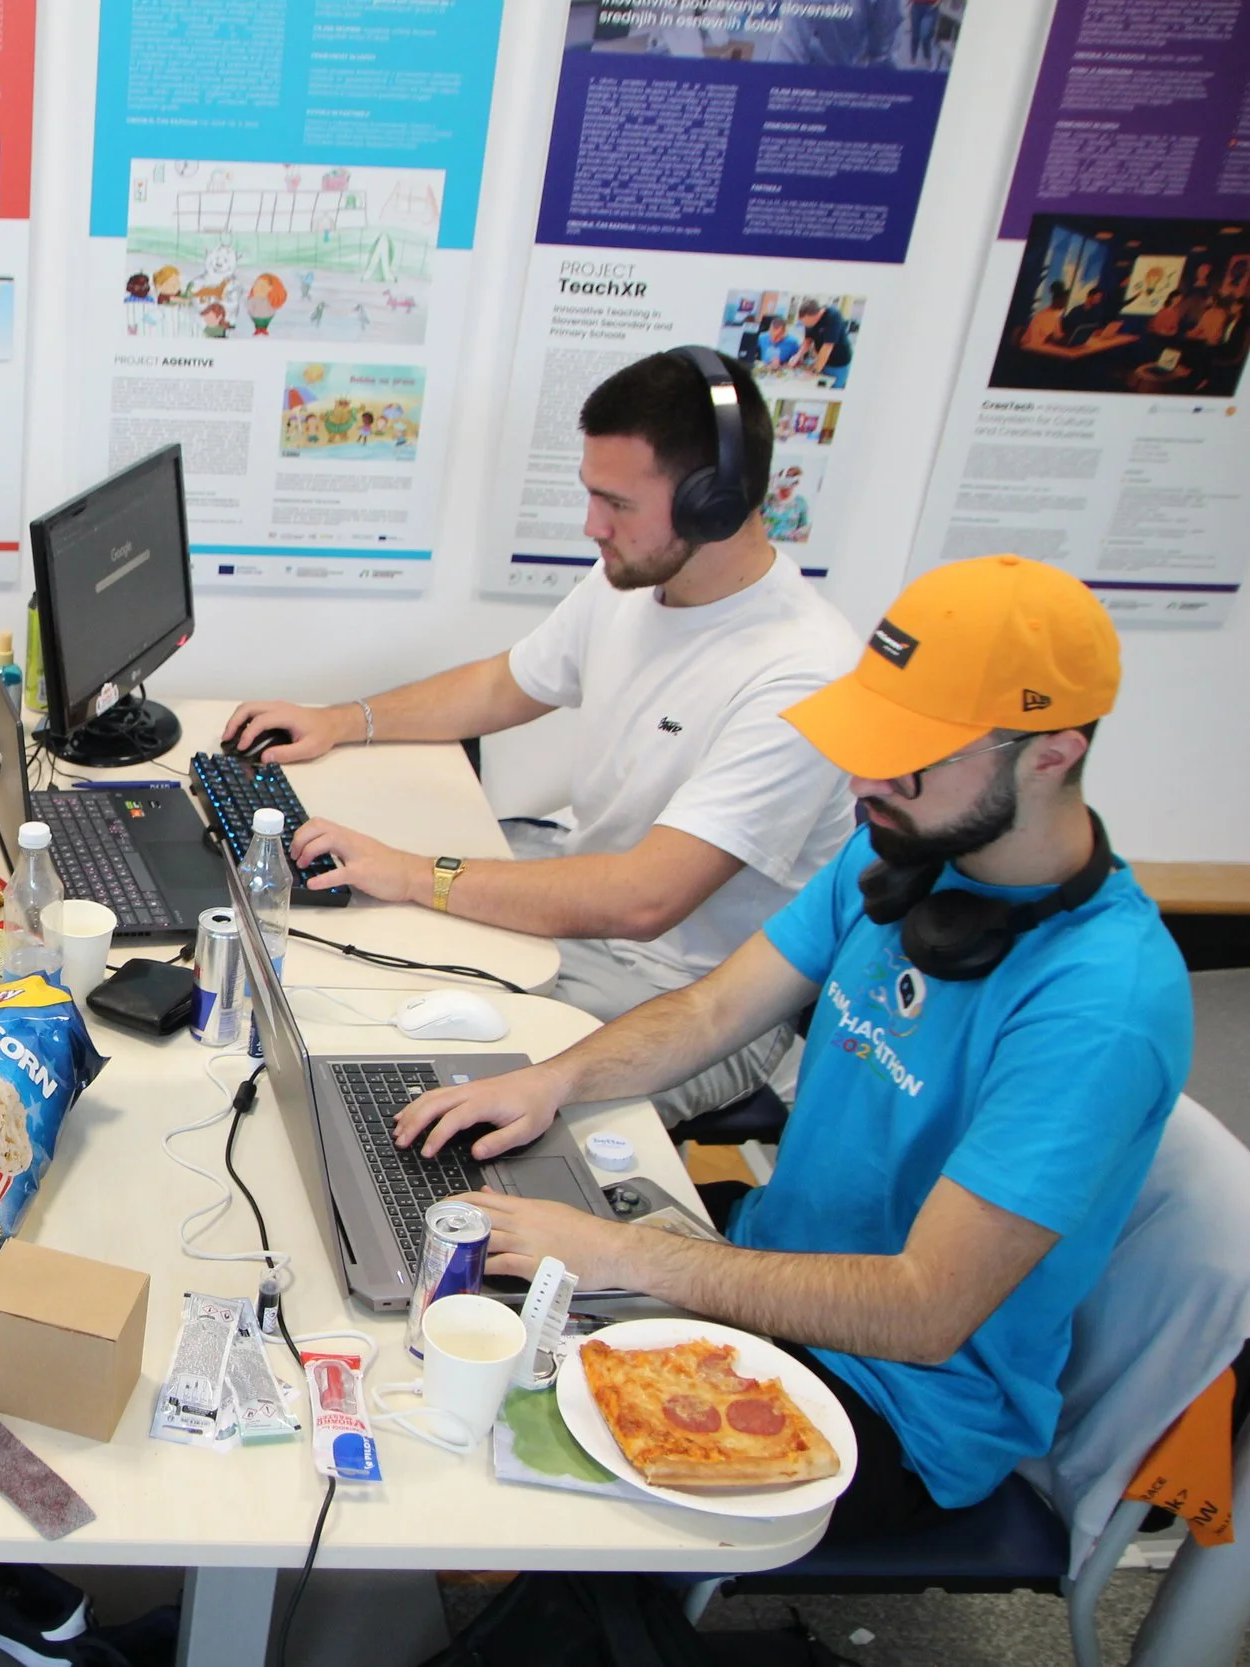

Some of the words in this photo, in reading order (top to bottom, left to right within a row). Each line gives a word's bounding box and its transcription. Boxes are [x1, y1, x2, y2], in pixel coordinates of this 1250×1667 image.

[559, 260, 636, 278] PROJECT
[559, 277, 647, 297] TeachXR
[161, 356, 215, 368] AGENTIVE
[110, 540, 133, 562] Google
[363, 1436, 374, 1461] PILOT
